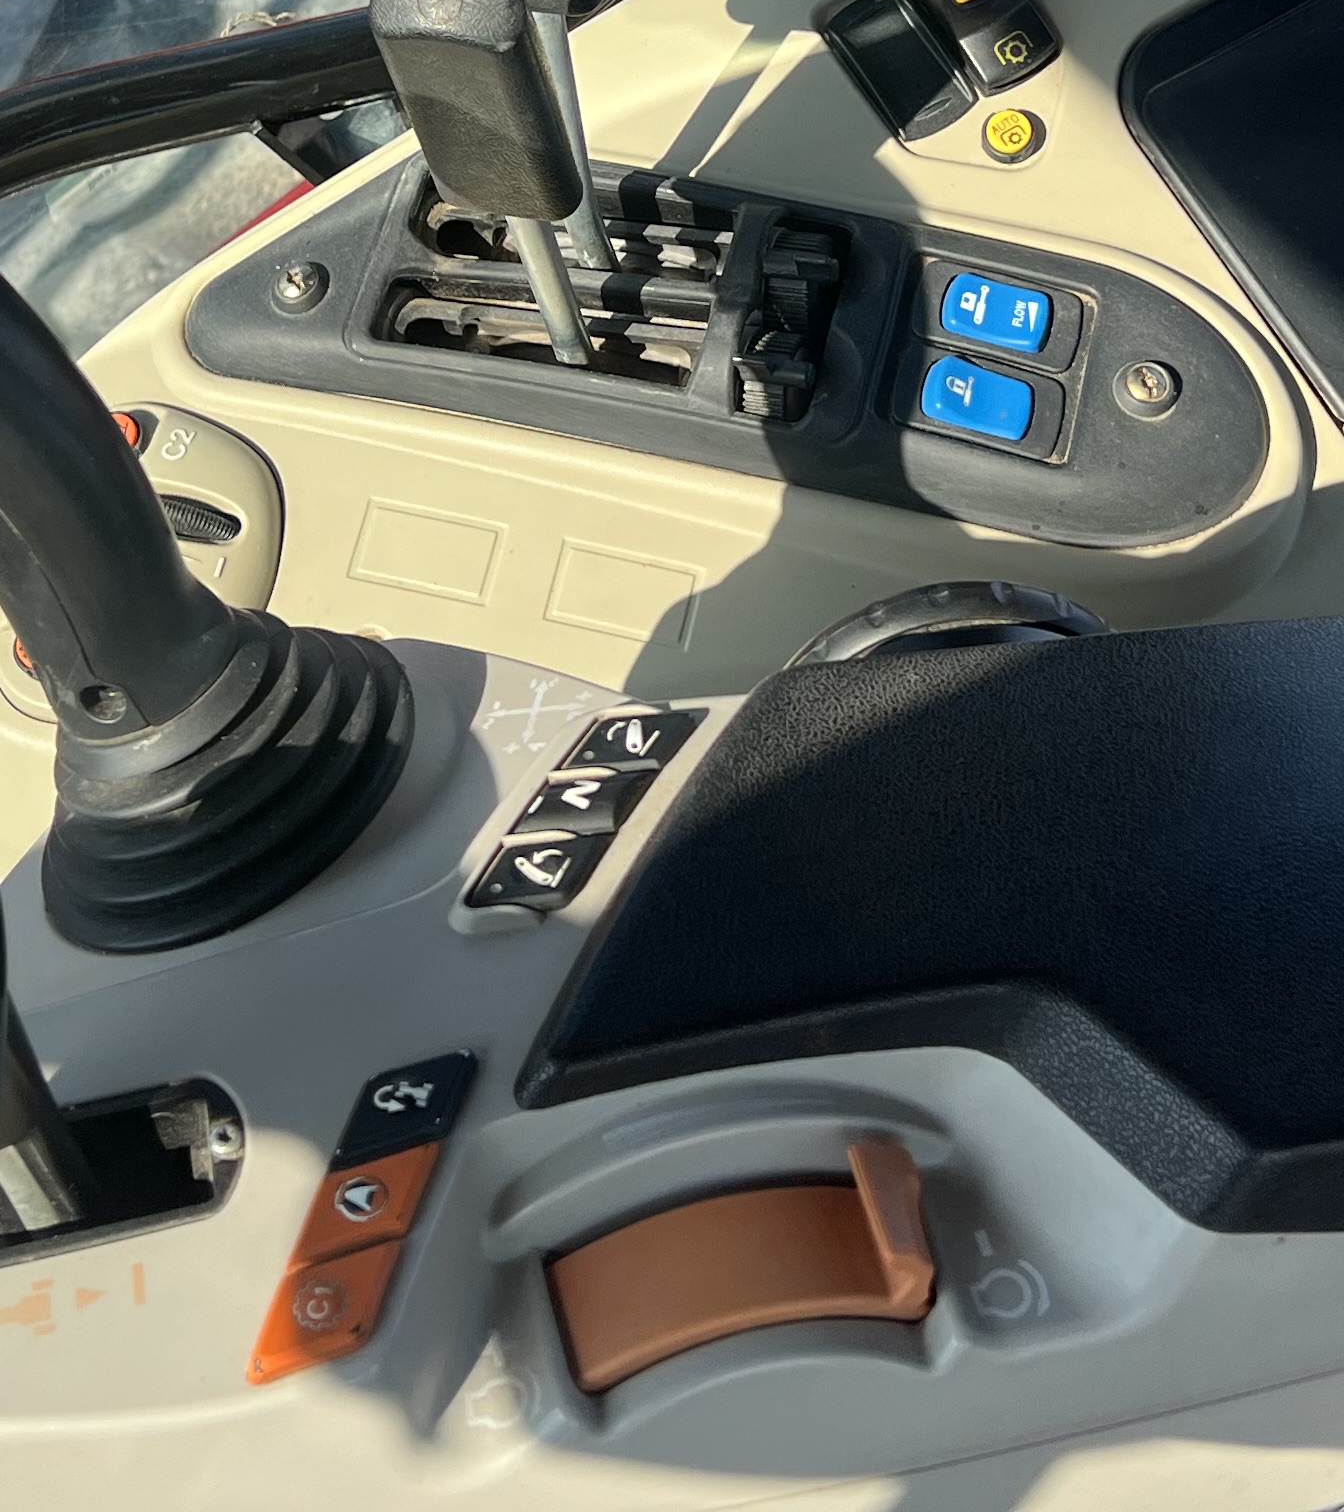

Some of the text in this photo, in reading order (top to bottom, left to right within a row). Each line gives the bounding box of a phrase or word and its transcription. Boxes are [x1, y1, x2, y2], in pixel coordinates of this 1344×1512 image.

[991, 113, 1020, 135] AUTO
[1011, 299, 1027, 328] FLOW
[161, 428, 196, 461] C2
[306, 1286, 334, 1320] C1
